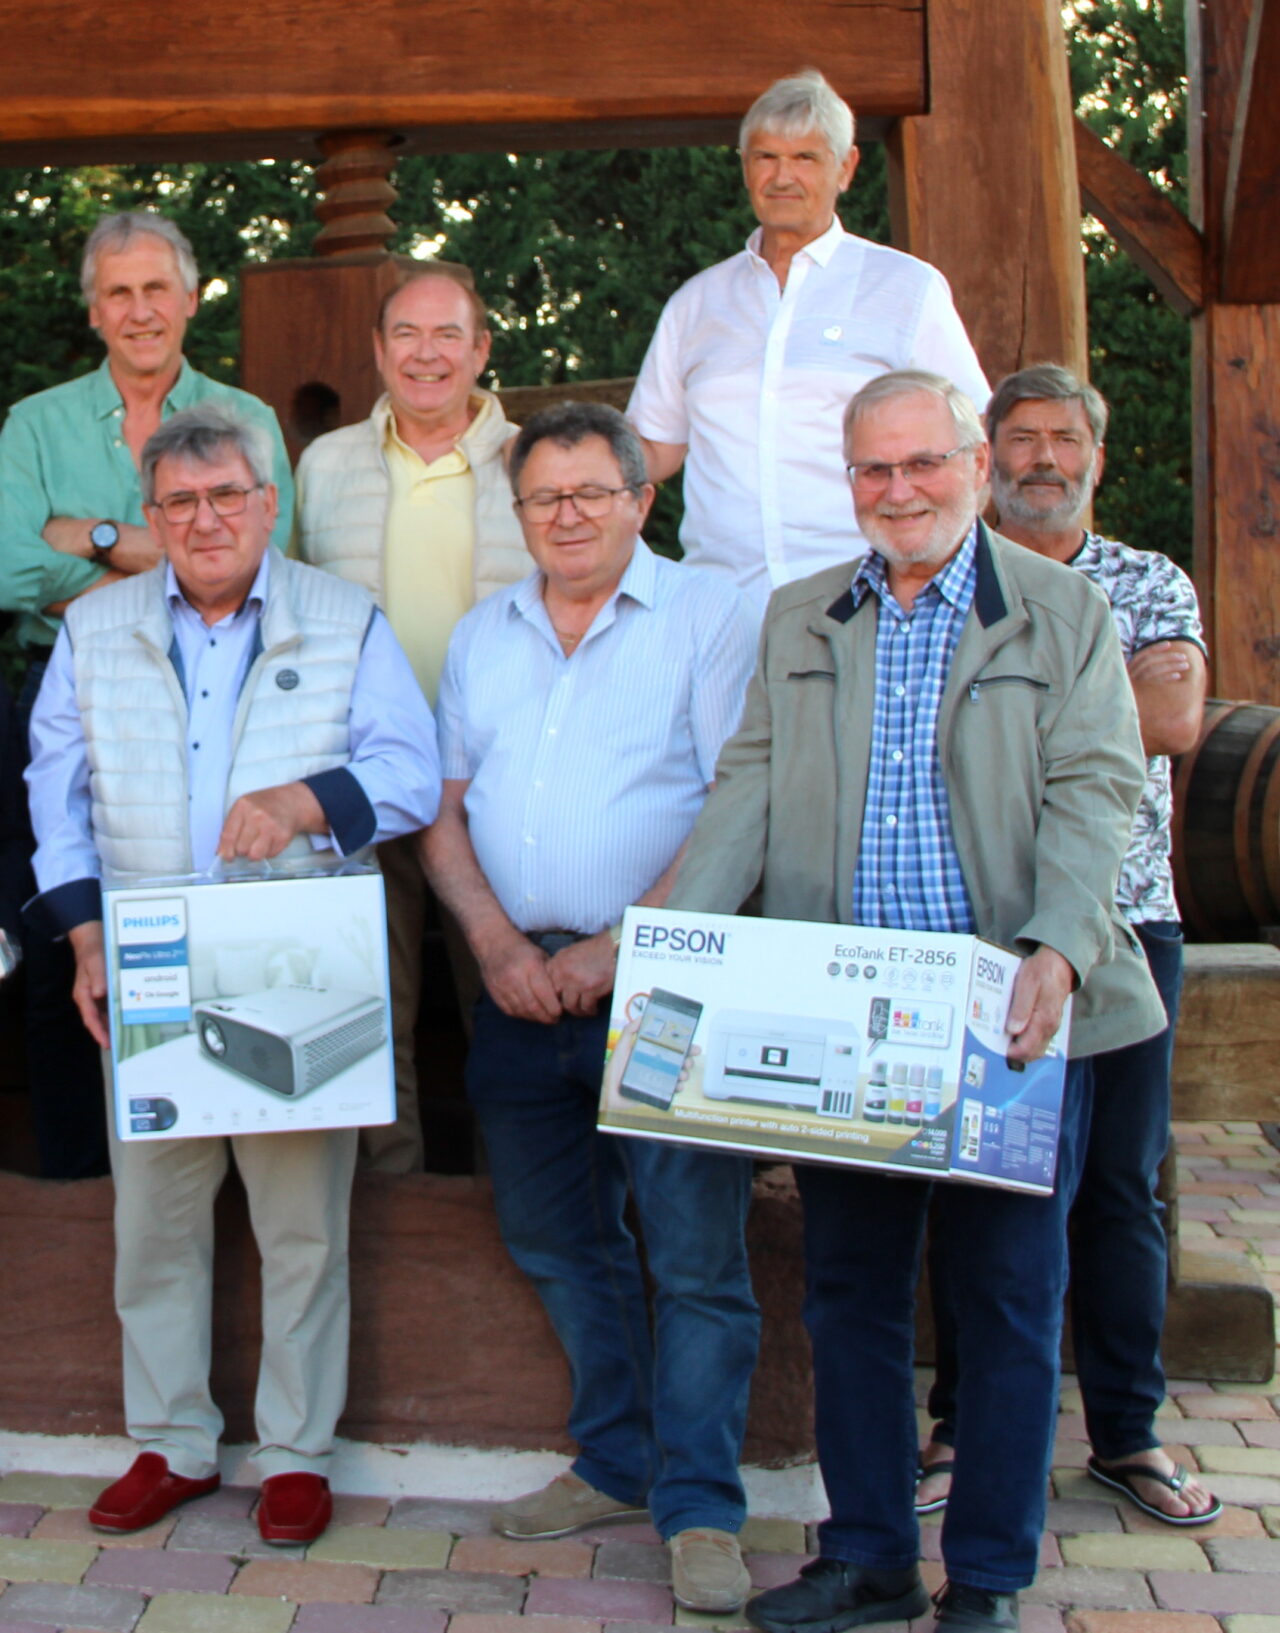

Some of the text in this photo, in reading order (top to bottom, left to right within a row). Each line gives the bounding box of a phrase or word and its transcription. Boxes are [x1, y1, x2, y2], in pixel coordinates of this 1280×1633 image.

[123, 914, 179, 928] PHILIPS
[634, 924, 726, 955] EPSON
[632, 950, 666, 960] EXCEED
[669, 953, 692, 962] YOUR
[834, 944, 957, 967] EcoTank ET-2856
[977, 955, 1006, 985] EPSON
[674, 1108, 869, 1144] Multifunction printer with auto 2-sided printing
